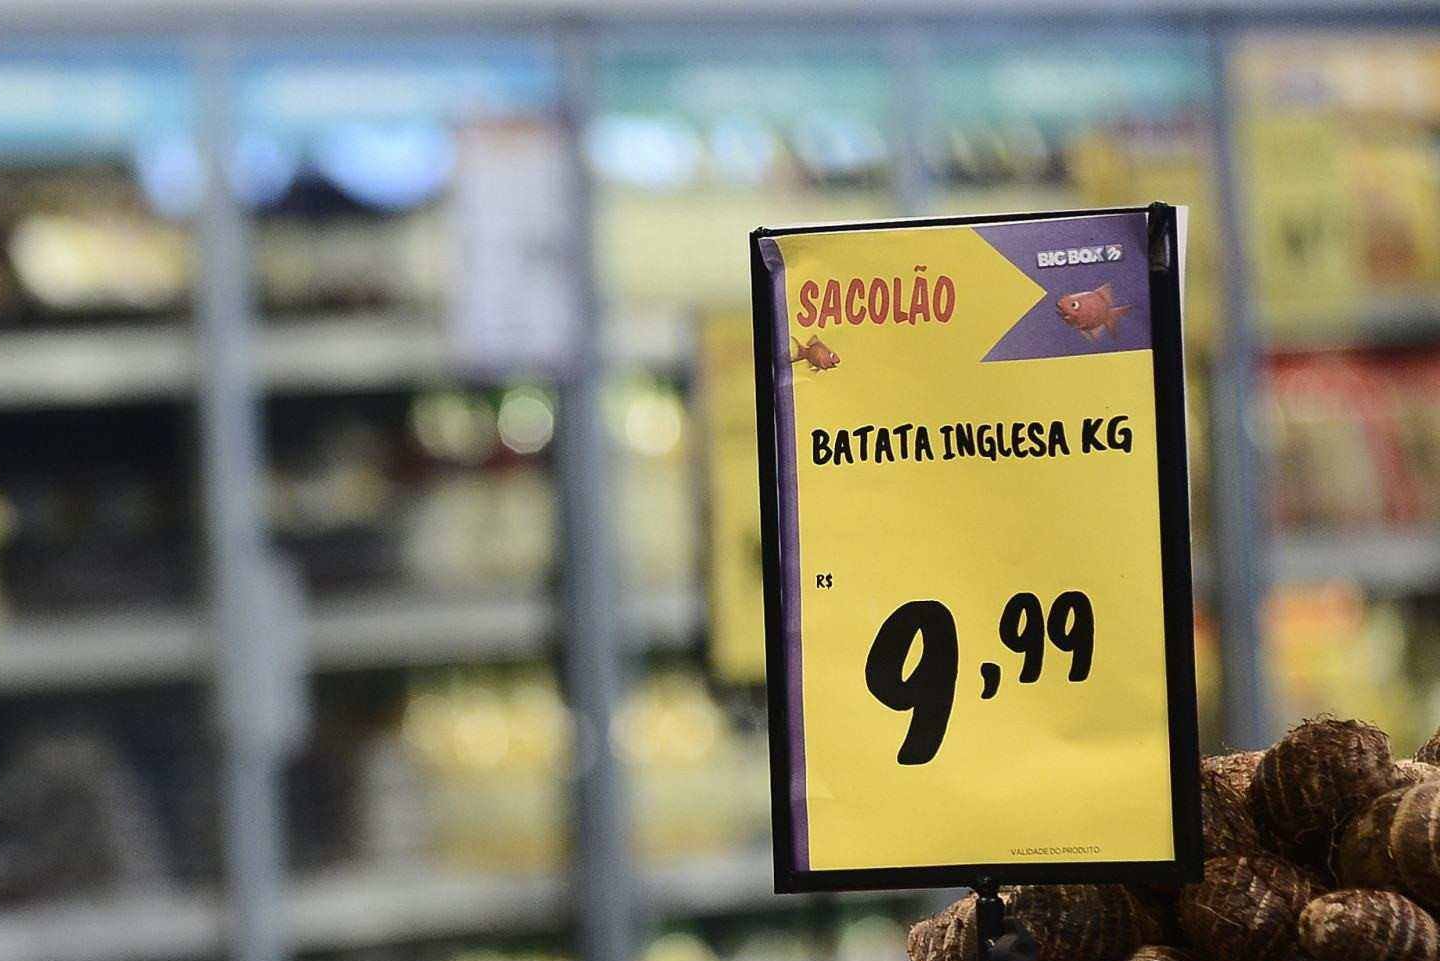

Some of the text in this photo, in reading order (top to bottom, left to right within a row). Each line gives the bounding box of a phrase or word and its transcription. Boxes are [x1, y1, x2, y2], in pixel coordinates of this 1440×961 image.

[1037, 246, 1105, 268] BIG BOX
[796, 264, 956, 329] SACOLÃO
[810, 415, 1133, 466] BATATA INGLESA KG
[815, 571, 833, 591] R$
[865, 590, 1095, 766] 9,99
